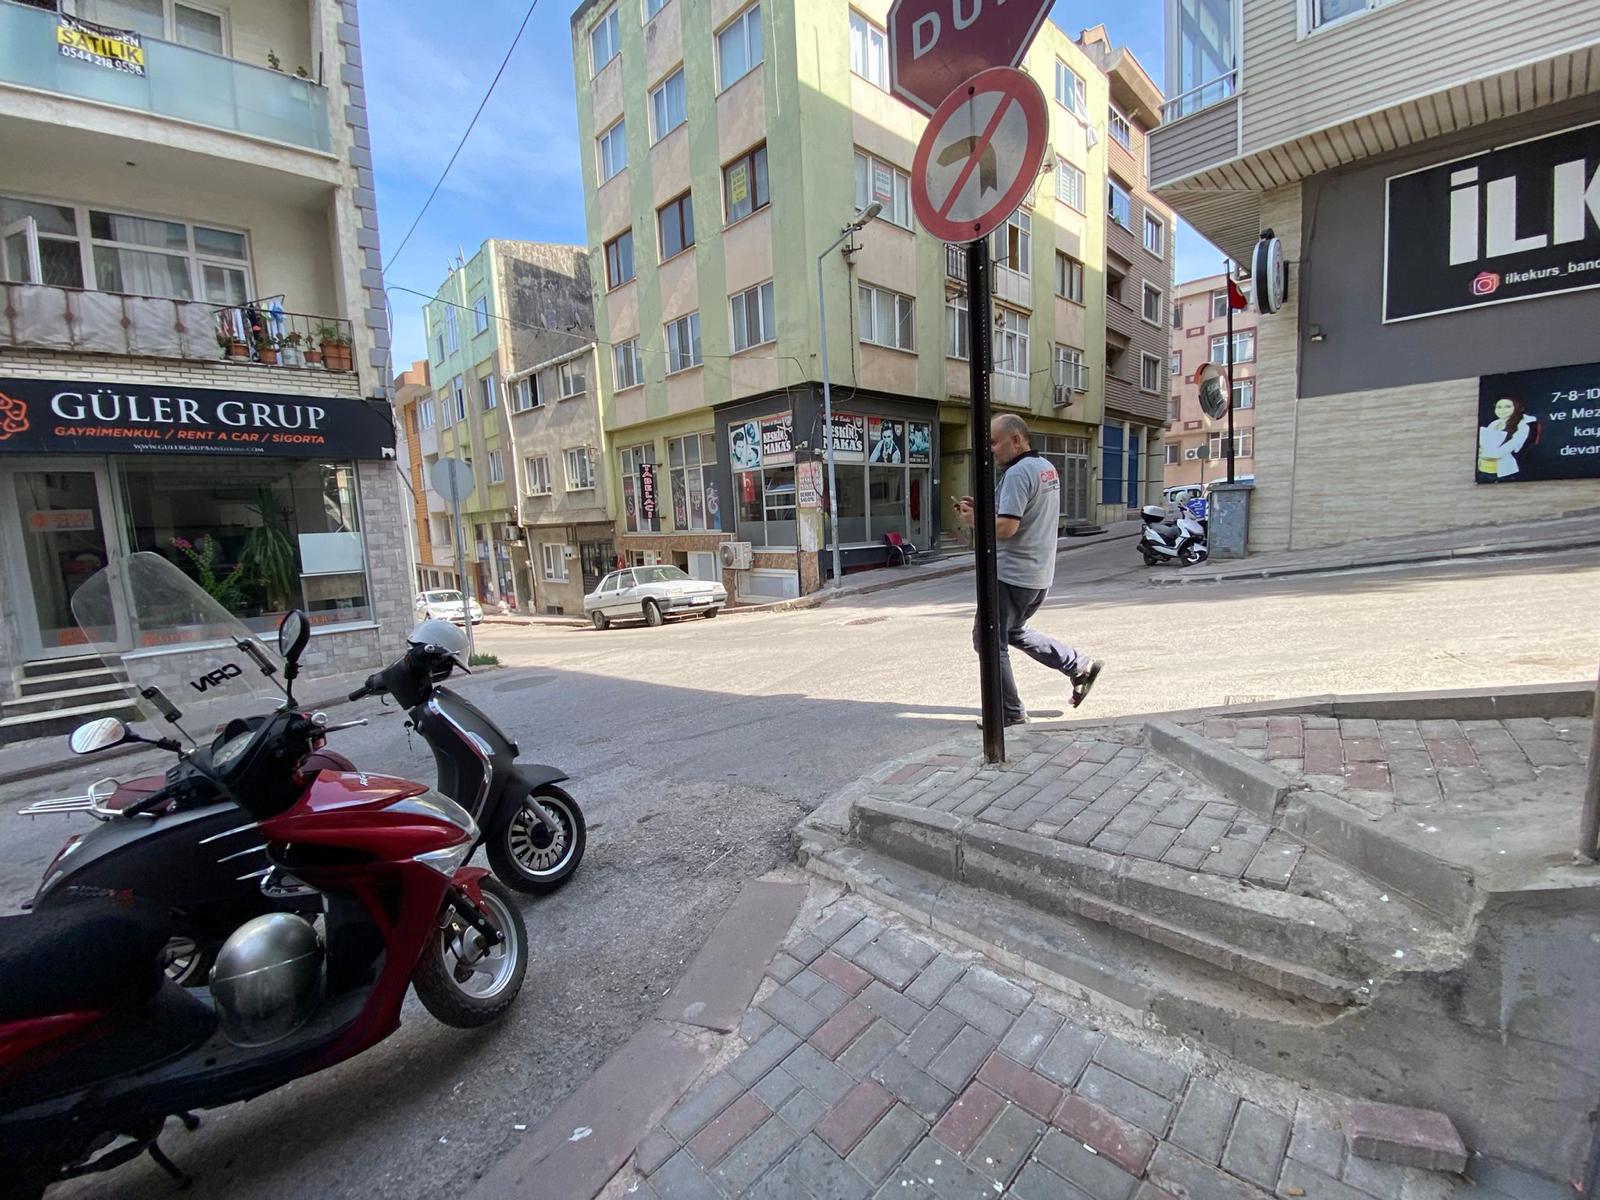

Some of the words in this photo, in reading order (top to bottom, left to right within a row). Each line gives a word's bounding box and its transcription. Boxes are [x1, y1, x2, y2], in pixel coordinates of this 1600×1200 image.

[913, 0, 1007, 60] DU
[62, 30, 141, 64] SATILIK
[62, 46, 92, 63] 0544
[51, 389, 210, 425] GÜLER
[216, 401, 325, 429] GRUP
[1549, 411, 1567, 421] ve
[1571, 407, 1600, 419] Mez
[54, 425, 162, 439] GAYRİMENKUL
[177, 430, 214, 440] RENT
[217, 431, 227, 440] A
[231, 432, 260, 441] CAR
[272, 433, 325, 444] SİGORTA
